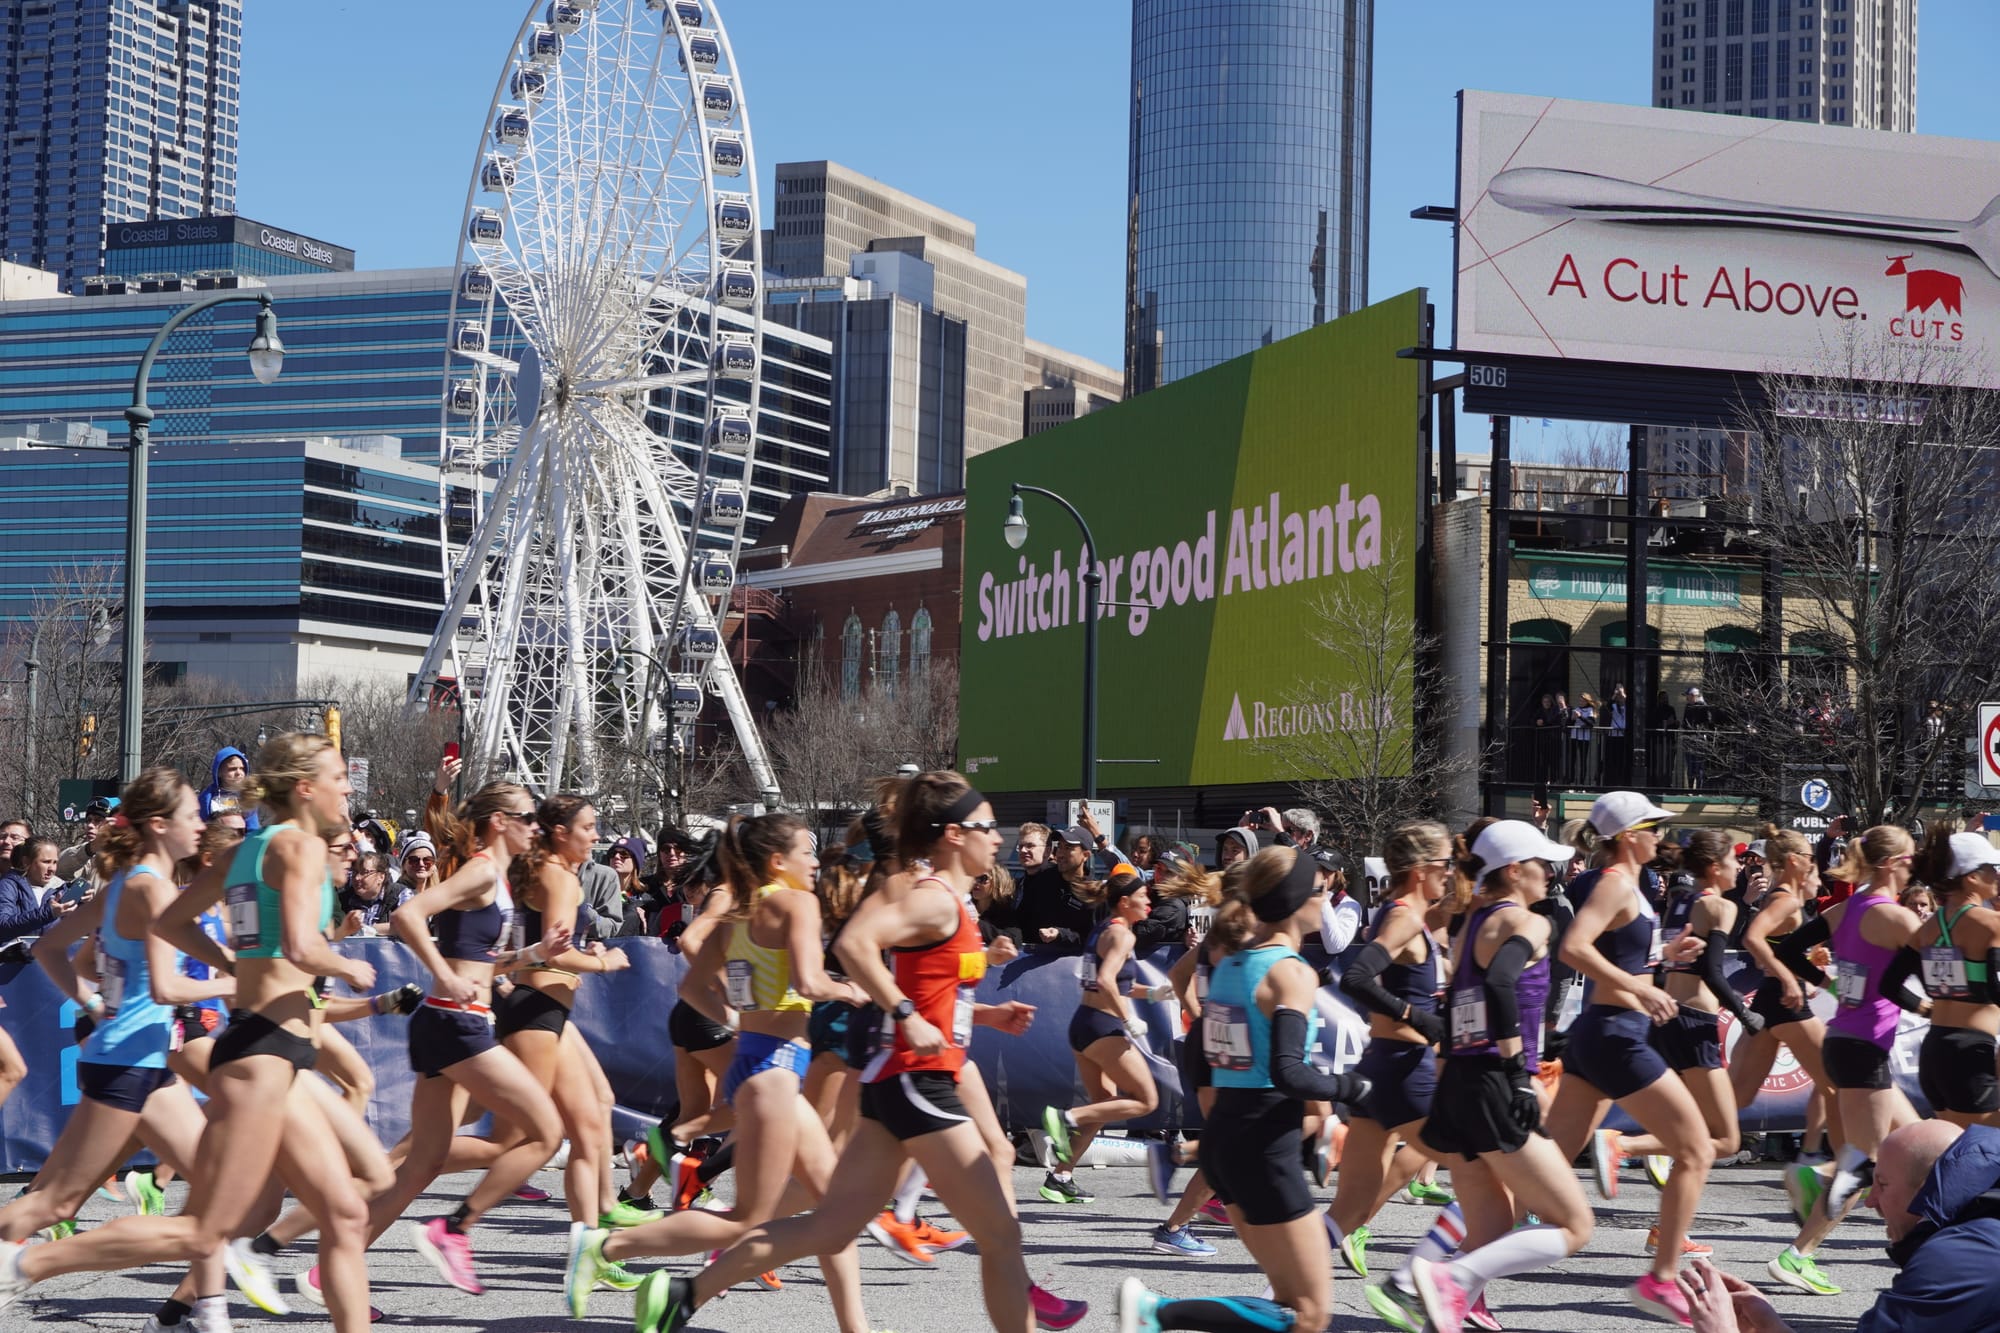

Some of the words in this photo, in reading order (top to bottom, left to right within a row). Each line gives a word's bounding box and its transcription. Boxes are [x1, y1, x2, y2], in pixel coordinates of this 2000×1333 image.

[120, 226, 169, 244] Coastal
[176, 222, 219, 240] States
[260, 228, 299, 255] Coastal
[302, 241, 334, 265] States
[1547, 253, 1588, 299] A
[1603, 257, 1689, 307] Cut
[1702, 265, 1868, 321] Above.
[1889, 317, 1964, 342] CUTS
[1471, 366, 1506, 386] 506
[977, 549, 1072, 642] Switch
[1077, 540, 1125, 624] for
[1127, 509, 1217, 637] good
[1222, 483, 1382, 596] Atlanta
[1571, 571, 1604, 595] PARK
[1676, 576, 1708, 600] PARK
[1339, 691, 1394, 732] BAK
[1094, 807, 1111, 816] LANE
[1792, 816, 1834, 828] PUBL
